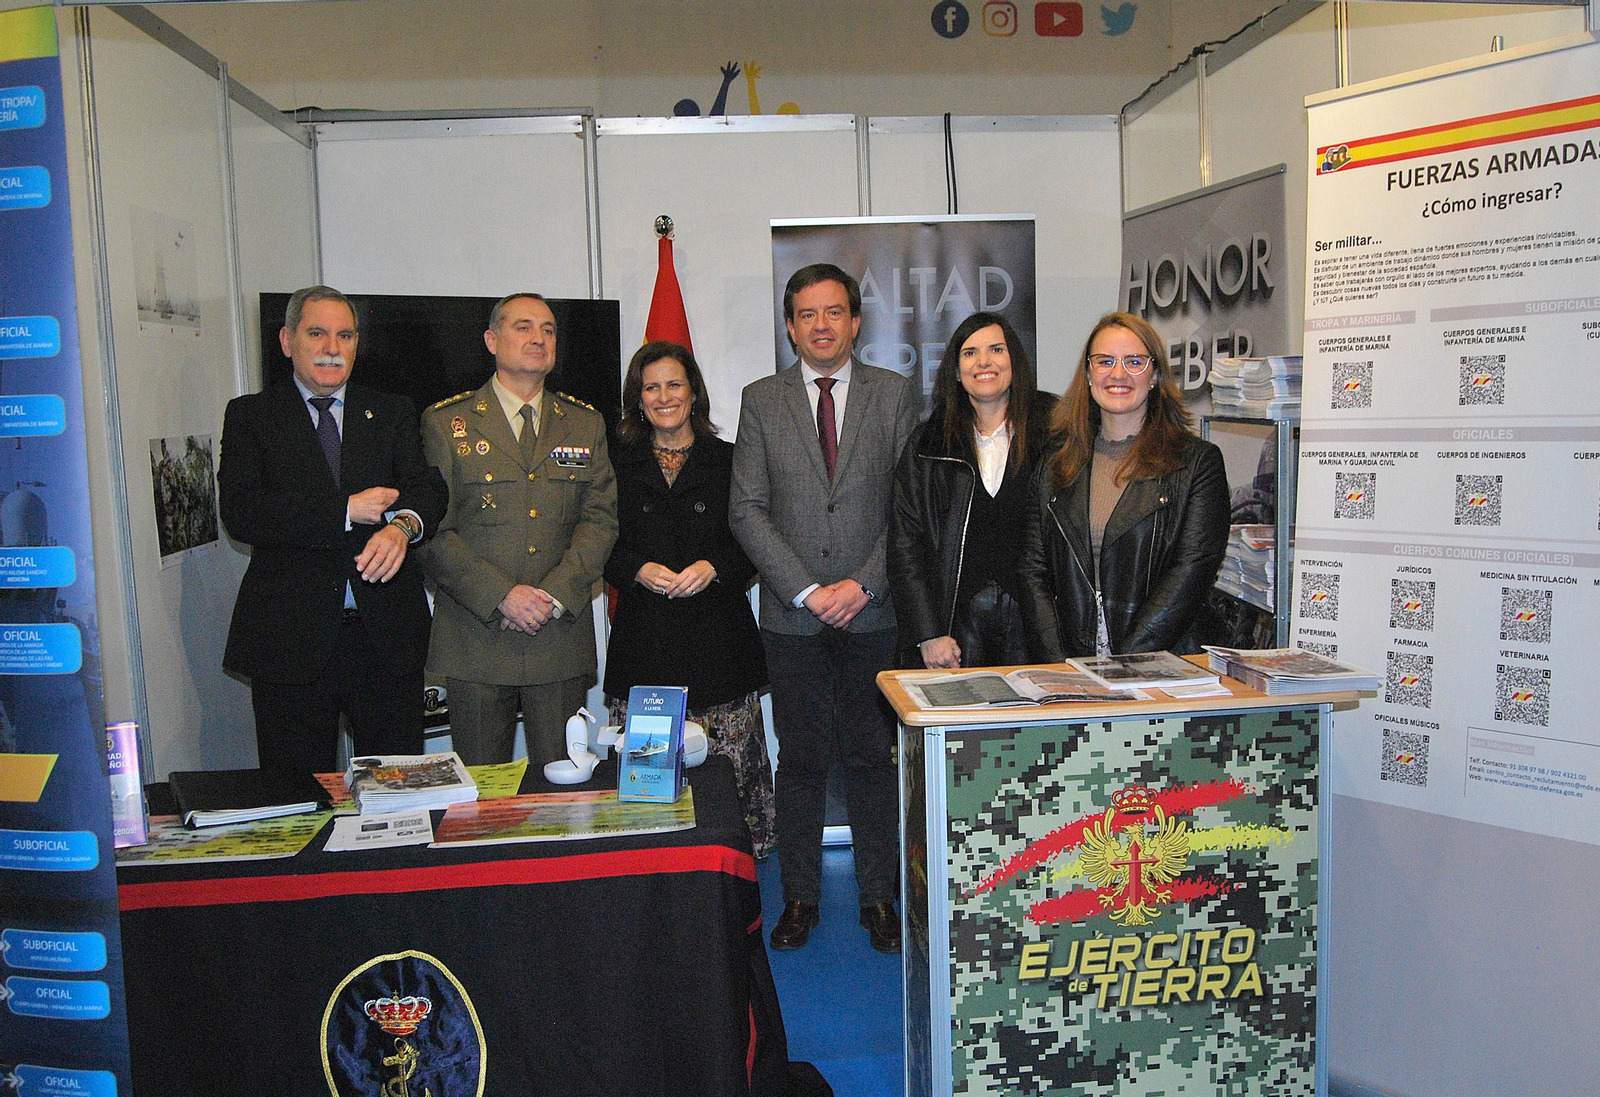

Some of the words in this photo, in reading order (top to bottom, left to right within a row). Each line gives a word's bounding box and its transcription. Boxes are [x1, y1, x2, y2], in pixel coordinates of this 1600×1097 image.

[1, 95, 37, 109] TROPA/
[0, 109, 18, 122] ERÍA
[1387, 158, 1479, 191] FUERZAS
[1486, 139, 1600, 176] ARMADA
[0, 178, 23, 189] CIAL
[1422, 197, 1476, 218] ¿Cómo
[1482, 182, 1562, 210] ingresar?
[1315, 240, 1332, 252] Ser
[1335, 235, 1382, 249] militar...
[1435, 244, 1454, 252] fuertes
[1456, 239, 1488, 249] emociones
[1494, 234, 1534, 245] experiencias
[1393, 256, 1412, 264] trabajo
[1414, 253, 1440, 262] dinámico
[1472, 247, 1499, 256] hombres
[1506, 244, 1531, 253] mujeres
[1533, 241, 1553, 249] tienen
[1563, 238, 1585, 246] misión
[1587, 236, 1595, 244] de
[1126, 232, 1274, 313] HONOR
[1342, 270, 1367, 278] bienestar
[1384, 265, 1408, 273] sociedad
[1386, 274, 1405, 282] orgullo
[1445, 267, 1468, 276] mejores
[1500, 261, 1531, 271] ayudando
[1550, 257, 1573, 265] demás
[858, 265, 1014, 315] ALTAD
[1345, 294, 1364, 302] quieres
[1366, 292, 1378, 300] ser?
[1525, 298, 1600, 313] SUBOFICIALE
[1311, 319, 1339, 329] TROPA
[1341, 318, 1348, 326] Y
[1349, 313, 1402, 325] MARINERÍA
[0, 327, 32, 338] FICIAL
[1443, 329, 1475, 338] CUERPOS
[1476, 326, 1520, 336] GENERALES
[1319, 337, 1346, 346] CUERPOS
[1348, 335, 1386, 344] GENERALES
[1444, 336, 1484, 347] INFANTERÍA
[1485, 336, 1495, 344] DE
[1496, 335, 1525, 343] MARINA
[1319, 344, 1354, 353] INFANTERÍA
[0, 405, 26, 416] ICIAL
[1453, 429, 1514, 440] OFICIALES
[1328, 451, 1368, 459] GENERALES,
[1370, 450, 1408, 459] INFANTERÍA
[1481, 452, 1526, 460] INGENIEROS
[1573, 452, 1600, 460] CUERP
[1393, 544, 1443, 557] CUERPOS
[1445, 547, 1500, 560] COMUNES
[1503, 551, 1574, 566] (OFICIALES)
[1300, 560, 1343, 568] INTERVENCIÓN
[1396, 565, 1432, 574] JURÍDICOS
[1480, 571, 1515, 580] MEDICINA
[1517, 573, 1529, 581] SIN
[1532, 575, 1577, 585] TITULACIÓN
[4, 631, 41, 641] OFICIAL
[1299, 628, 1337, 638] ENFERMERÍA
[1394, 638, 1428, 648] FARMACIA
[1499, 650, 1549, 661] VETERINARIA
[1374, 714, 1409, 725] OFICIALES
[1409, 719, 1440, 730] MÚSICOS
[1469, 765, 1485, 773] Email:
[1482, 759, 1508, 768] Contacto:
[14, 840, 70, 851] SUBOFICIAL
[23, 939, 78, 952] SUBOFICIAL
[1018, 928, 1255, 980] EJÉRCITO
[1068, 979, 1088, 993] de
[1093, 963, 1263, 1008] TIERRA
[36, 988, 72, 999] OFICIAL
[45, 1076, 81, 1089] OFICIAL
